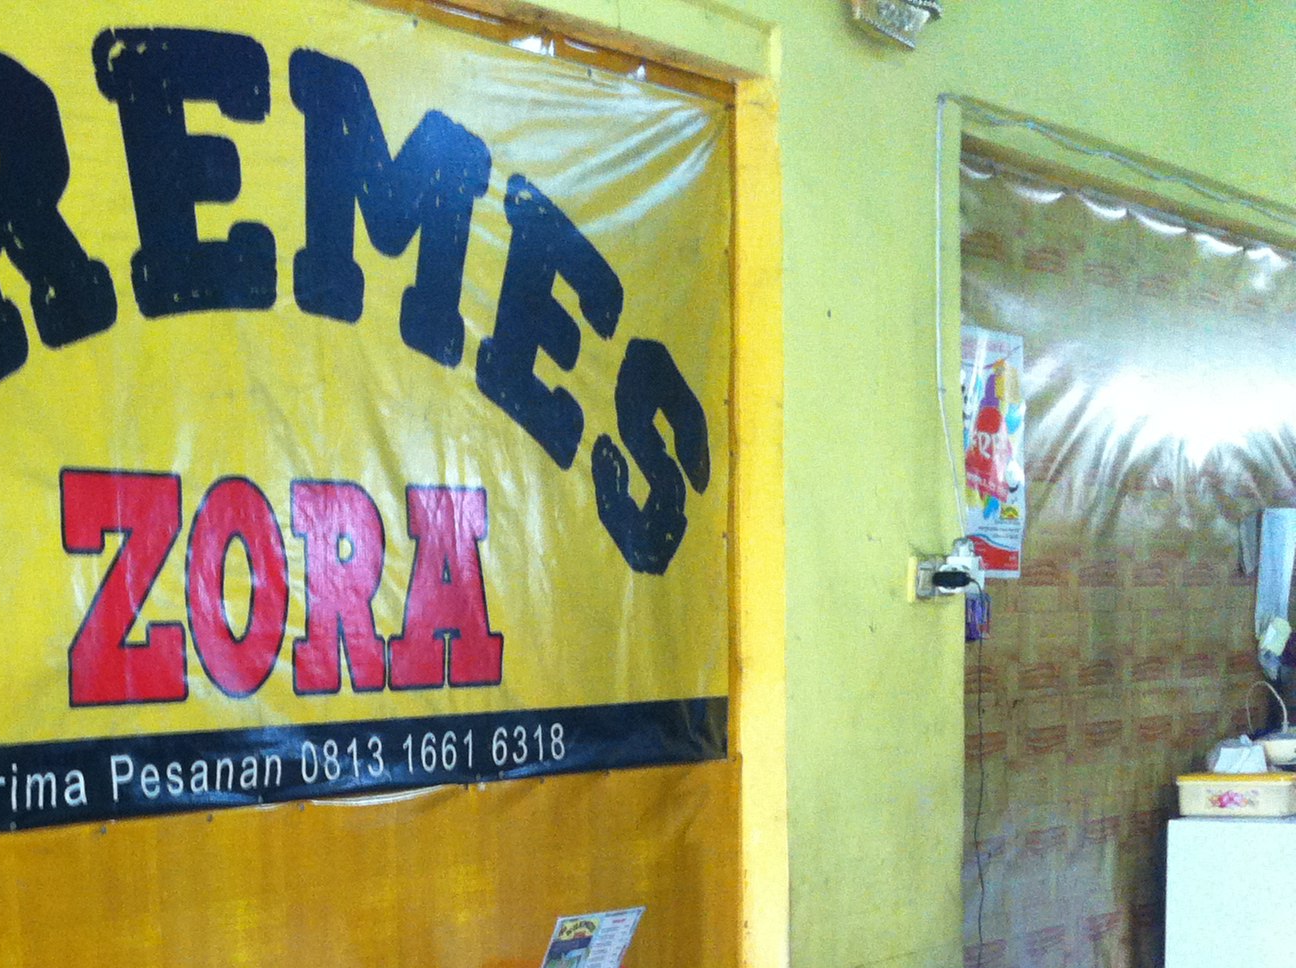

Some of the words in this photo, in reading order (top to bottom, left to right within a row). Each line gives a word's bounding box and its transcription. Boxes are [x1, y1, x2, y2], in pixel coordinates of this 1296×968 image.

[59, 467, 504, 708] ZORA
[109, 753, 283, 803] Pesanan
[300, 735, 385, 785] 0813
[402, 729, 474, 775] 1661
[491, 722, 566, 768] 6318
